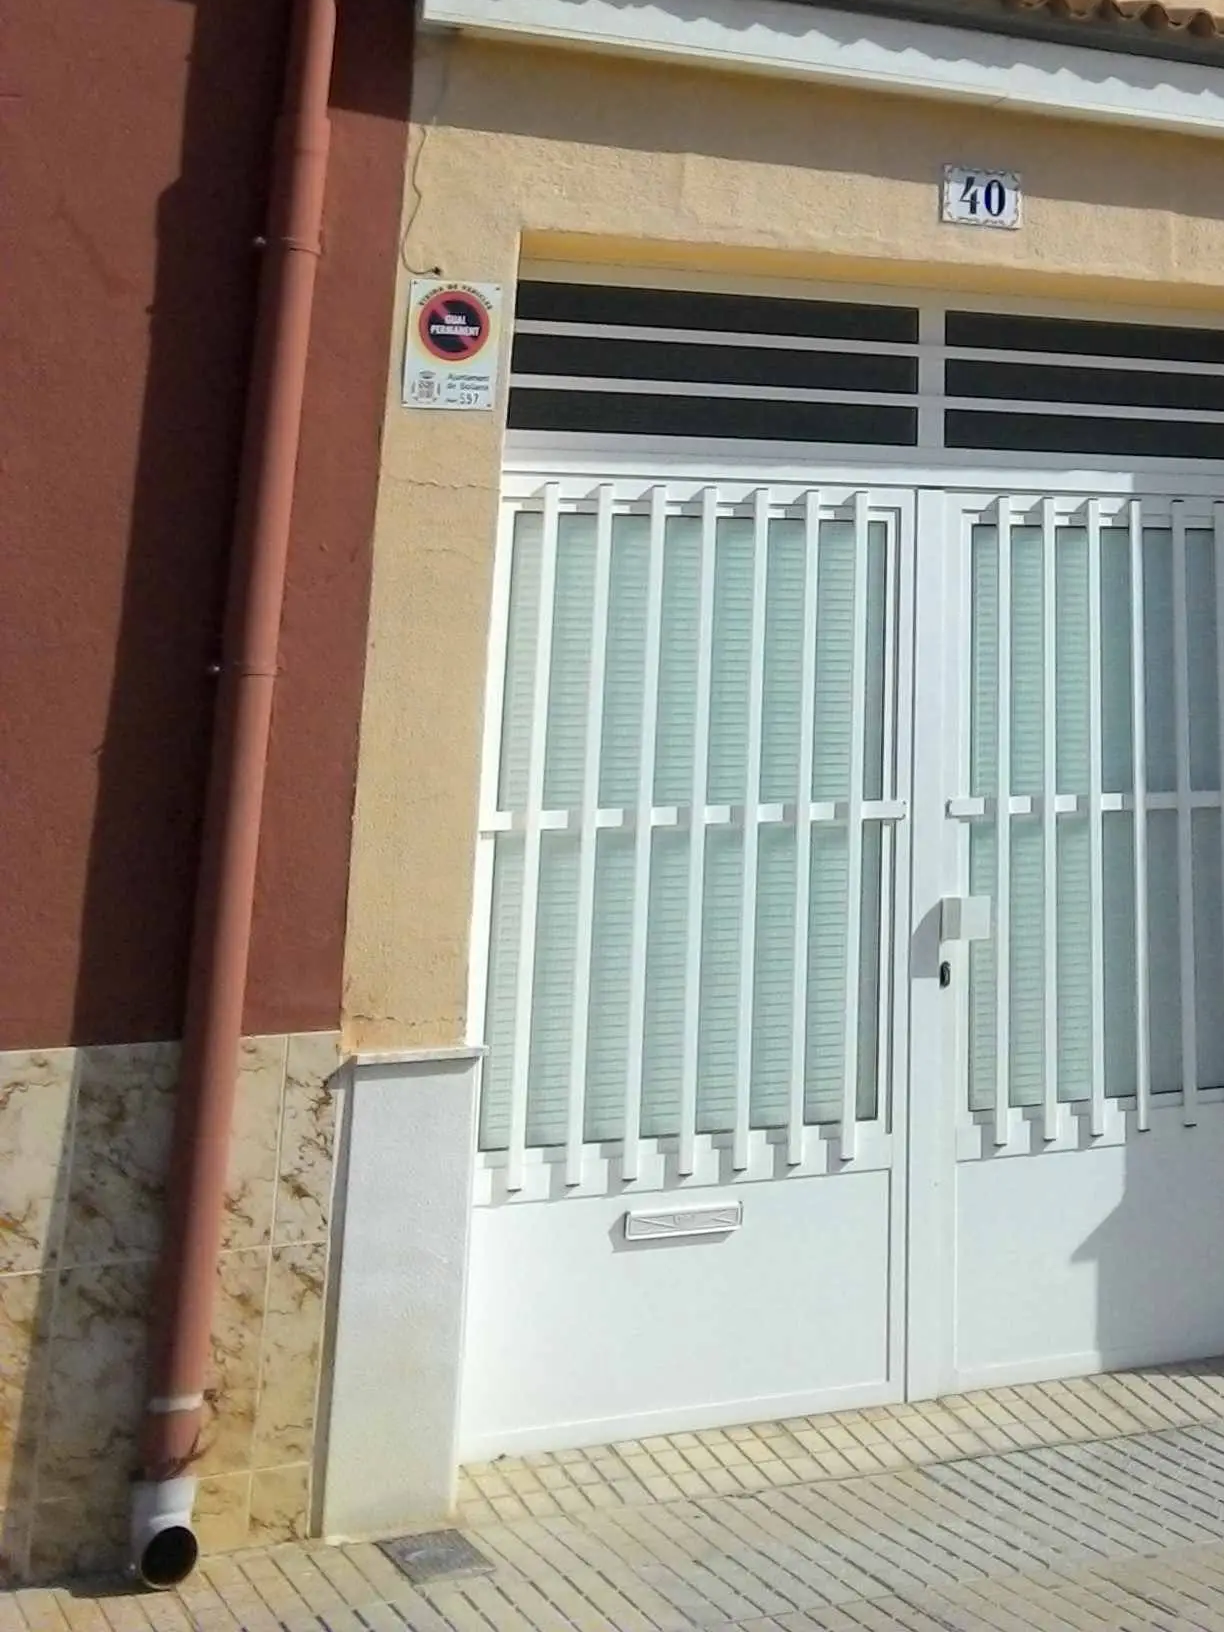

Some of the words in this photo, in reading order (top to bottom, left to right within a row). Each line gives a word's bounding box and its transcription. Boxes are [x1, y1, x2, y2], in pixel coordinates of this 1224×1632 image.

[959, 176, 1006, 217] 40
[444, 314, 466, 325] GUAL
[430, 324, 480, 337] PERMANENT
